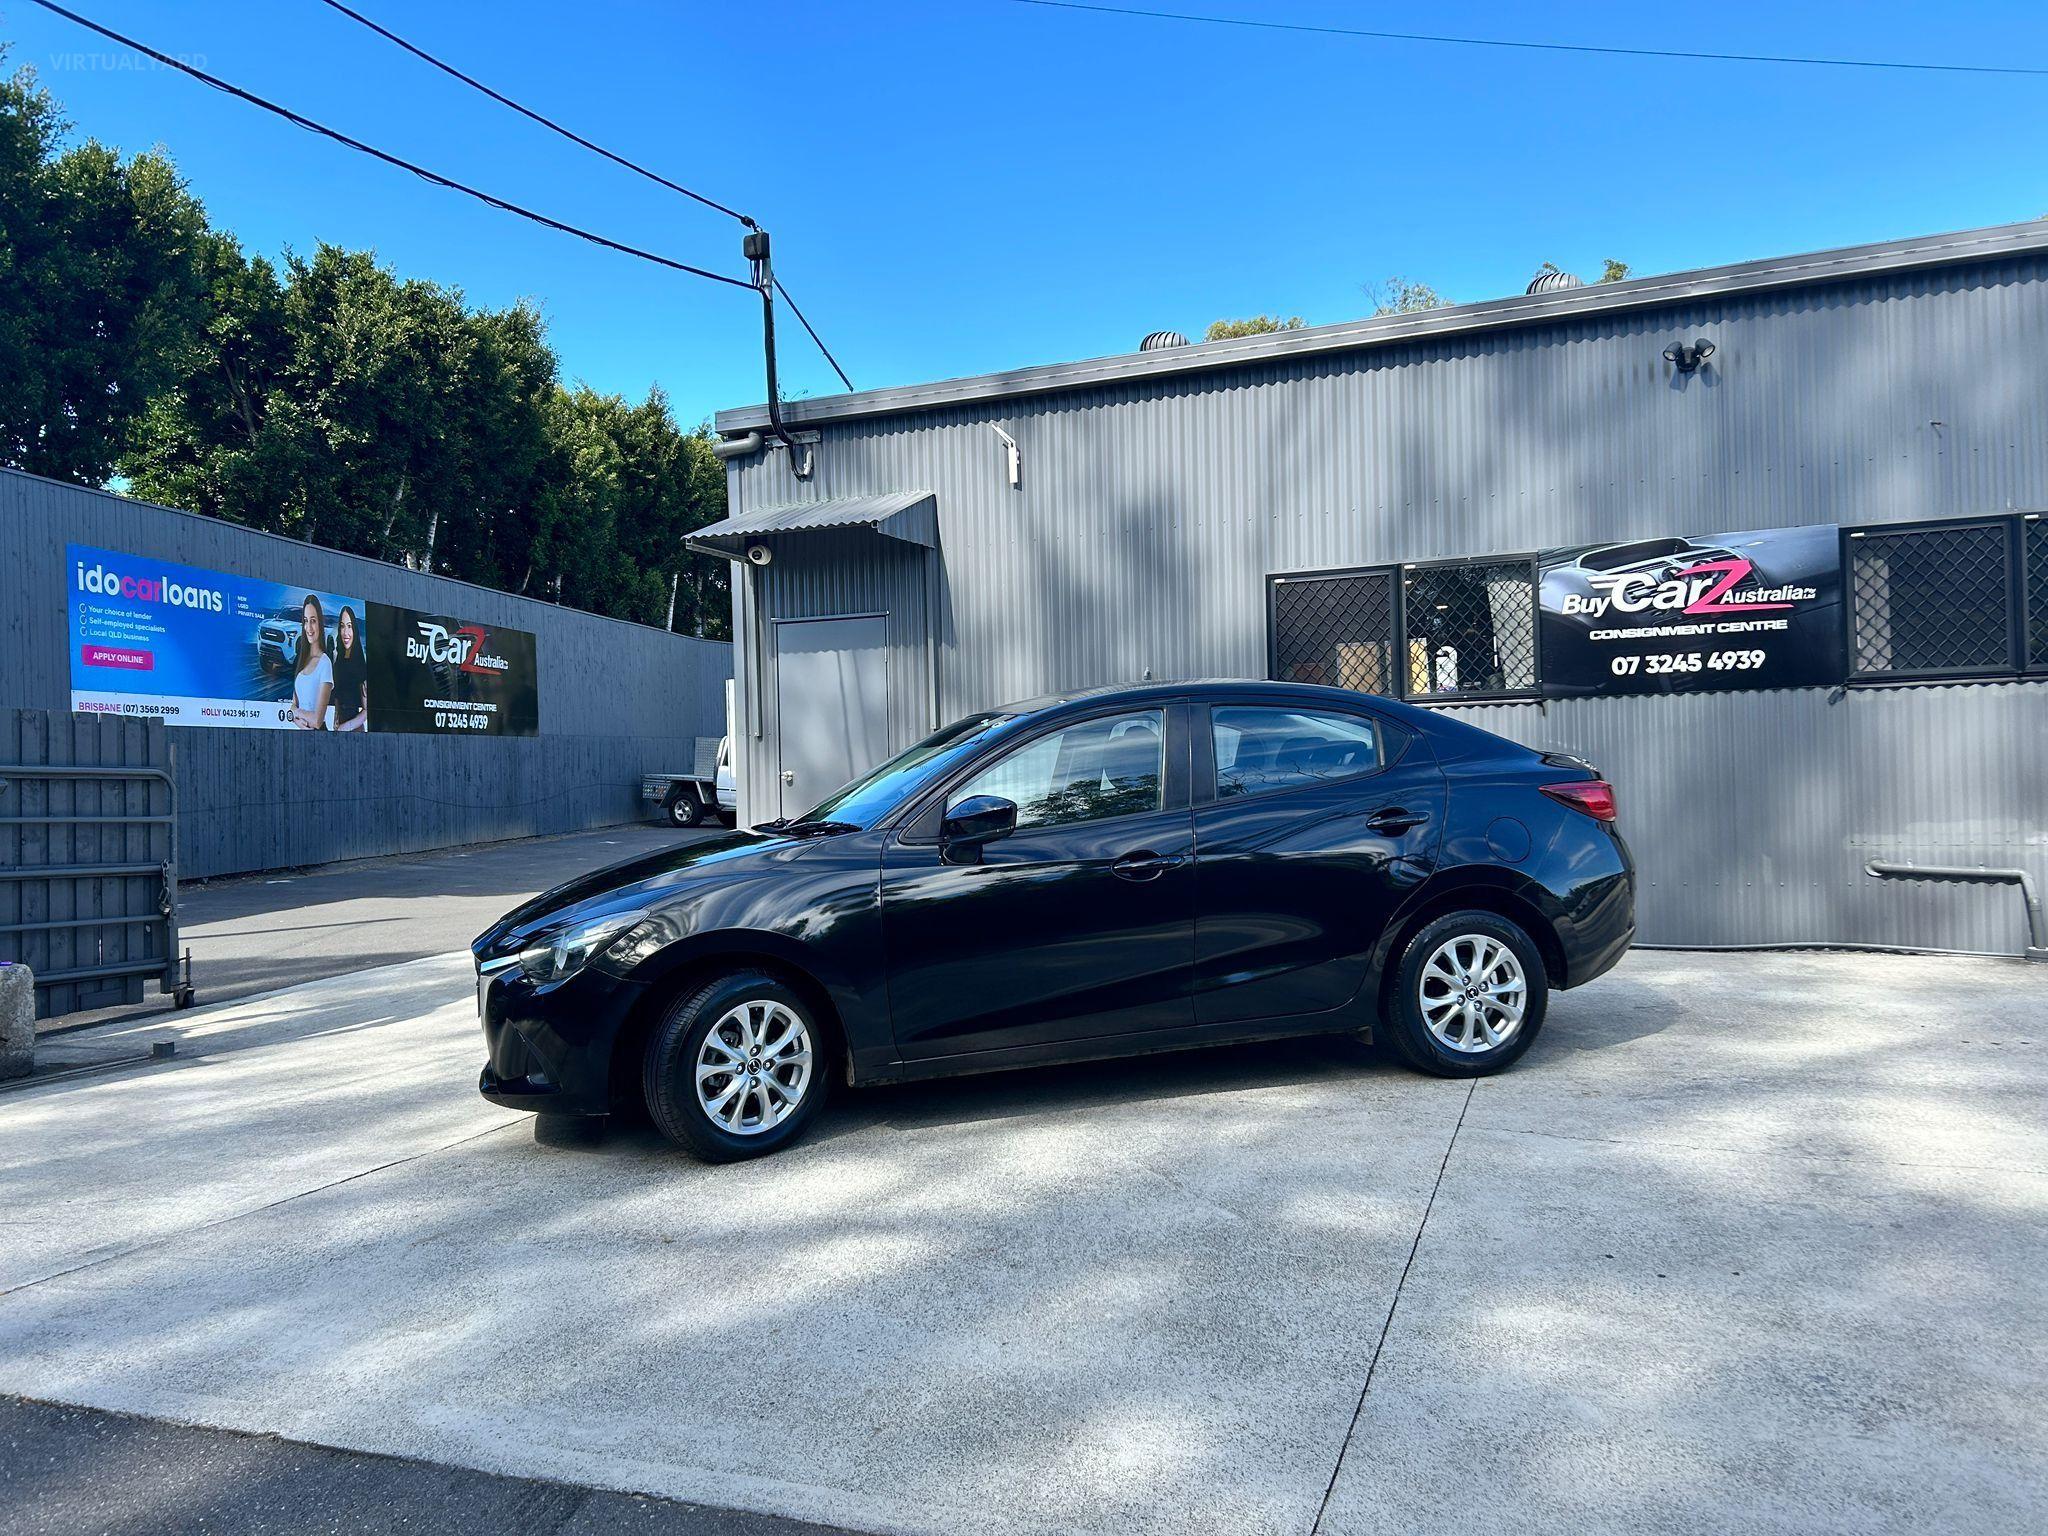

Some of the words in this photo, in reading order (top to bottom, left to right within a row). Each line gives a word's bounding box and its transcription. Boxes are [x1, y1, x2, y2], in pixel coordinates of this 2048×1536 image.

[77, 561, 223, 612] idocarloans
[1720, 584, 1803, 604] Australia
[88, 605, 103, 614] Your
[104, 608, 125, 616] choice
[133, 612, 153, 620] lender
[89, 617, 134, 629] Self-employed
[135, 623, 166, 633] specialists
[1589, 623, 1716, 641] CONSIGNMENT
[1716, 619, 1788, 633] CENTRE
[89, 629, 107, 637] Local
[108, 631, 122, 639] QLD
[123, 633, 149, 642] business
[92, 651, 117, 662] APPLY
[117, 653, 144, 664] ONLINE
[474, 653, 504, 669] Australia
[1611, 656, 1641, 676] 07
[1645, 652, 1703, 674] 3245
[1707, 650, 1766, 671] 4939
[78, 701, 121, 713] BRISBANE
[122, 703, 139, 714] (07)
[139, 704, 160, 714] 3569
[160, 704, 180, 715] 2999
[423, 699, 473, 710] CONSIGNMENT
[473, 702, 498, 711] CENTRE
[201, 708, 222, 718] HOLLY
[222, 709, 238, 718] 0423
[238, 709, 249, 718] 961
[249, 709, 260, 719] 547
[435, 713, 446, 727] 07
[447, 713, 468, 728] 3245
[469, 714, 489, 730] 4939
